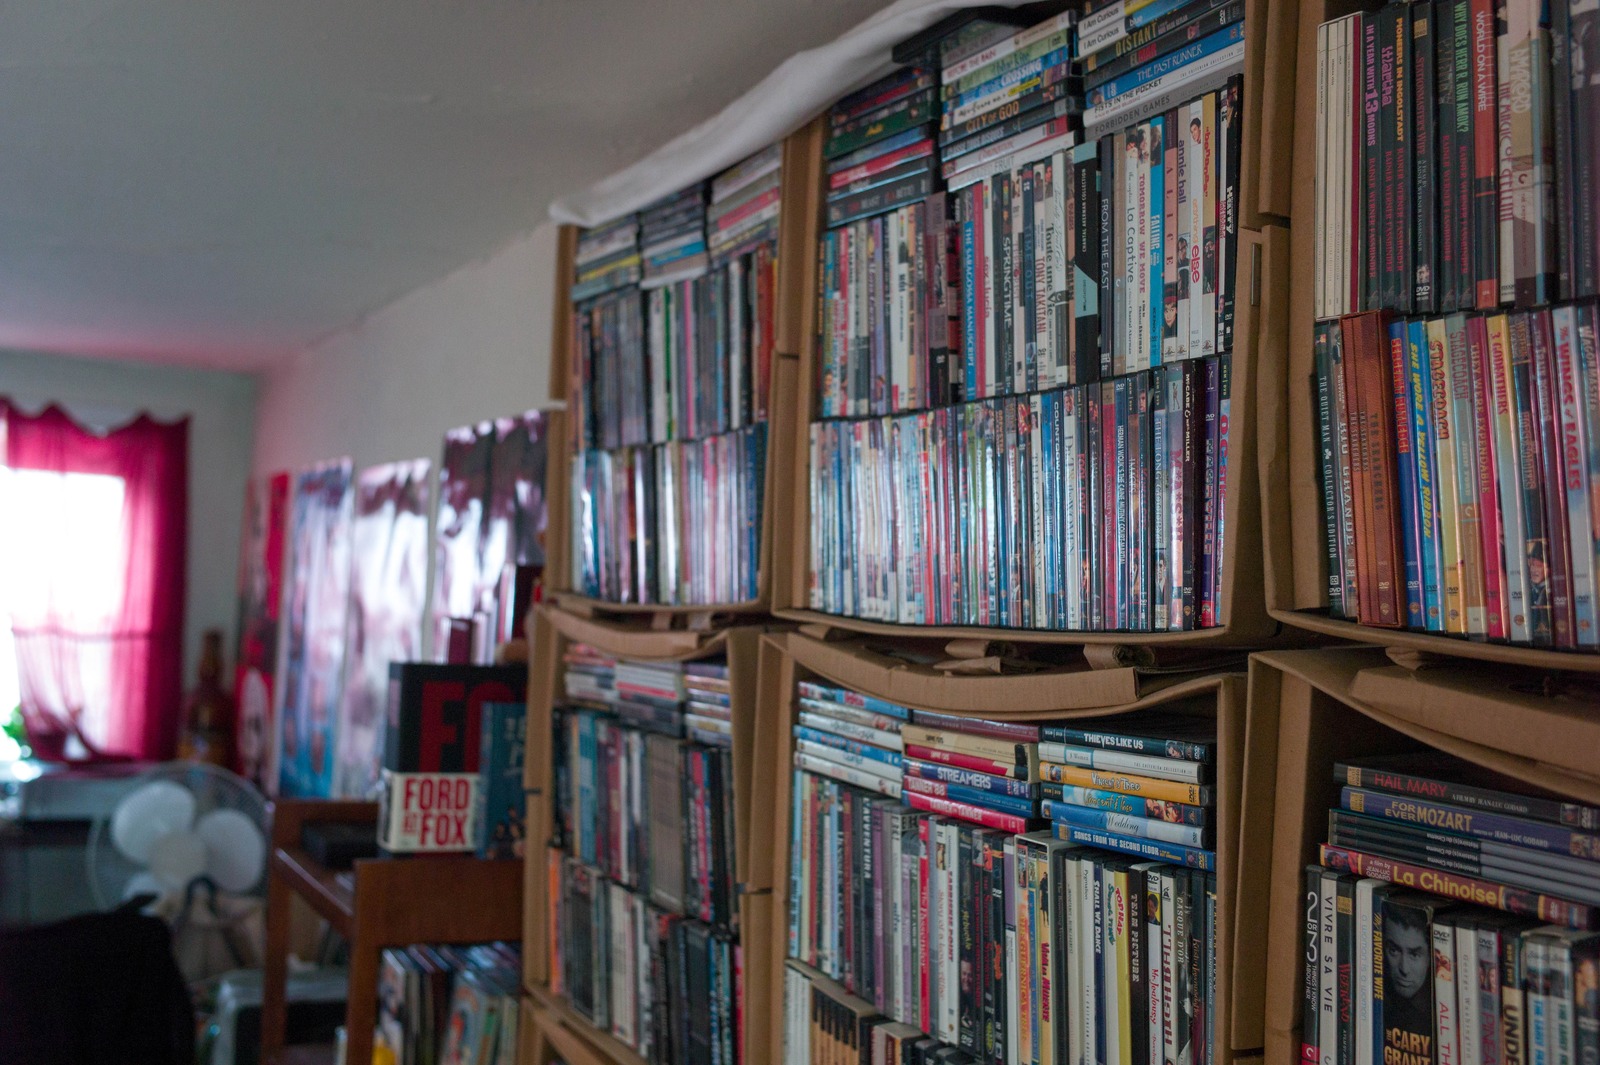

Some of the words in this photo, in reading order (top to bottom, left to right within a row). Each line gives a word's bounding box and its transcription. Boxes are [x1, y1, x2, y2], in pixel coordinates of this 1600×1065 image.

[1097, 7, 1120, 25] Curious
[1454, 1, 1467, 24] WHY
[1097, 27, 1120, 45] Curious
[1115, 22, 1158, 57] DISTANT
[1366, 24, 1374, 35] IN
[1455, 24, 1468, 48] DOES
[1476, 11, 1486, 53] WORLD
[1136, 68, 1152, 84] THE
[1152, 60, 1172, 77] FAST
[1171, 44, 1204, 68] RUNNER
[1366, 43, 1374, 65] YEAR
[1455, 47, 1468, 72] HERR
[1476, 54, 1486, 72] ON
[1366, 66, 1375, 90] WITH
[1396, 66, 1403, 79] IN
[1477, 74, 1486, 83] A
[1094, 100, 1113, 113] FISTS
[1134, 78, 1162, 97] POCKET
[1365, 90, 1379, 114] 13
[1456, 82, 1469, 102] RUN
[1478, 82, 1487, 113] WIRE
[999, 100, 1020, 121] GOD
[1094, 111, 1141, 135] FORBIDDEN
[1142, 95, 1172, 114] GAMES
[1396, 80, 1404, 143] INGOLSTADT
[1456, 102, 1469, 133] AMOK?
[1367, 114, 1376, 147] MOONS
[1178, 139, 1187, 177] annie
[1138, 172, 1146, 235] TOMORROW
[1178, 180, 1187, 205] hall
[1101, 198, 1109, 233] FROM
[1127, 206, 1136, 223] La
[1045, 223, 1055, 258] Toute
[1101, 235, 1109, 258] THE
[1150, 213, 1160, 250] FALLING
[1126, 227, 1137, 285] Captive
[1138, 241, 1146, 260] WE
[1190, 244, 1201, 284] else
[1003, 236, 1012, 329] SPRINGTIME
[1035, 256, 1045, 283] TONY
[1046, 264, 1054, 291] une
[1101, 261, 1109, 291] EAST
[1138, 263, 1146, 294] MOVE
[1036, 287, 1047, 334] TAKITANI
[1491, 331, 1502, 341] 3
[1391, 338, 1405, 395] SERGEANT
[1410, 342, 1420, 371] SHE
[1470, 342, 1481, 377] THEY
[1320, 375, 1328, 393] THE
[1491, 342, 1509, 417] GODFATHERS
[1557, 342, 1575, 407] WINGS
[1412, 373, 1424, 412] WORE
[1429, 340, 1450, 442] STAGECOACH
[1473, 379, 1484, 414] WERE
[1320, 395, 1330, 422] QUIET
[1322, 424, 1331, 443] MAN
[1395, 396, 1409, 455] RUTLEDGE
[1417, 431, 1429, 481] YELLOW
[1477, 417, 1489, 494] EXPENDABLE
[1565, 421, 1582, 491] EAGLES
[1323, 464, 1335, 520] COLLECTOR'S
[1423, 486, 1432, 539] RIBBON
[1327, 523, 1337, 559] EDITION
[1083, 733, 1115, 748] THIEVES
[1115, 737, 1134, 749] LIKE
[1133, 740, 1144, 750] US
[936, 767, 992, 790] STREAMERS
[1374, 773, 1403, 792] HAIL
[1406, 780, 1449, 799] MARY
[403, 778, 470, 811] FORD
[1391, 800, 1417, 814] FOR
[419, 813, 468, 847] FOX
[1107, 811, 1140, 833] Wedding
[1385, 807, 1417, 822] EVER
[1416, 803, 1474, 833] MOZART
[1074, 830, 1092, 842] SONGS
[1092, 834, 1108, 846] FROM
[1108, 837, 1119, 848] THE
[1119, 839, 1142, 852] SECOND
[1141, 844, 1160, 856] FLOOR
[1494, 830, 1523, 845] JEAN-LUC
[1523, 836, 1549, 849] GODARD
[1393, 865, 1415, 886] La
[1419, 871, 1497, 906] Chinoise
[1094, 910, 1101, 925] WE
[1131, 894, 1139, 928] TEAM
[1176, 896, 1184, 937] CASQUE
[1307, 891, 1318, 922] 2
[1324, 895, 1333, 944] VIVRE
[1307, 923, 1317, 931] OR
[1361, 924, 1369, 961] woman
[1131, 930, 1140, 982] PICTURE
[1177, 941, 1185, 965] D'OR
[1306, 930, 1317, 963] 3
[1373, 930, 1383, 976] FAVORITE
[1324, 954, 1333, 976] SA
[1149, 981, 1160, 1025] Jealousy
[1324, 986, 1333, 1013] VIE
[1373, 976, 1384, 1001] WIFE
[1439, 1001, 1450, 1037] ALL
[1392, 1027, 1431, 1056] CARY
